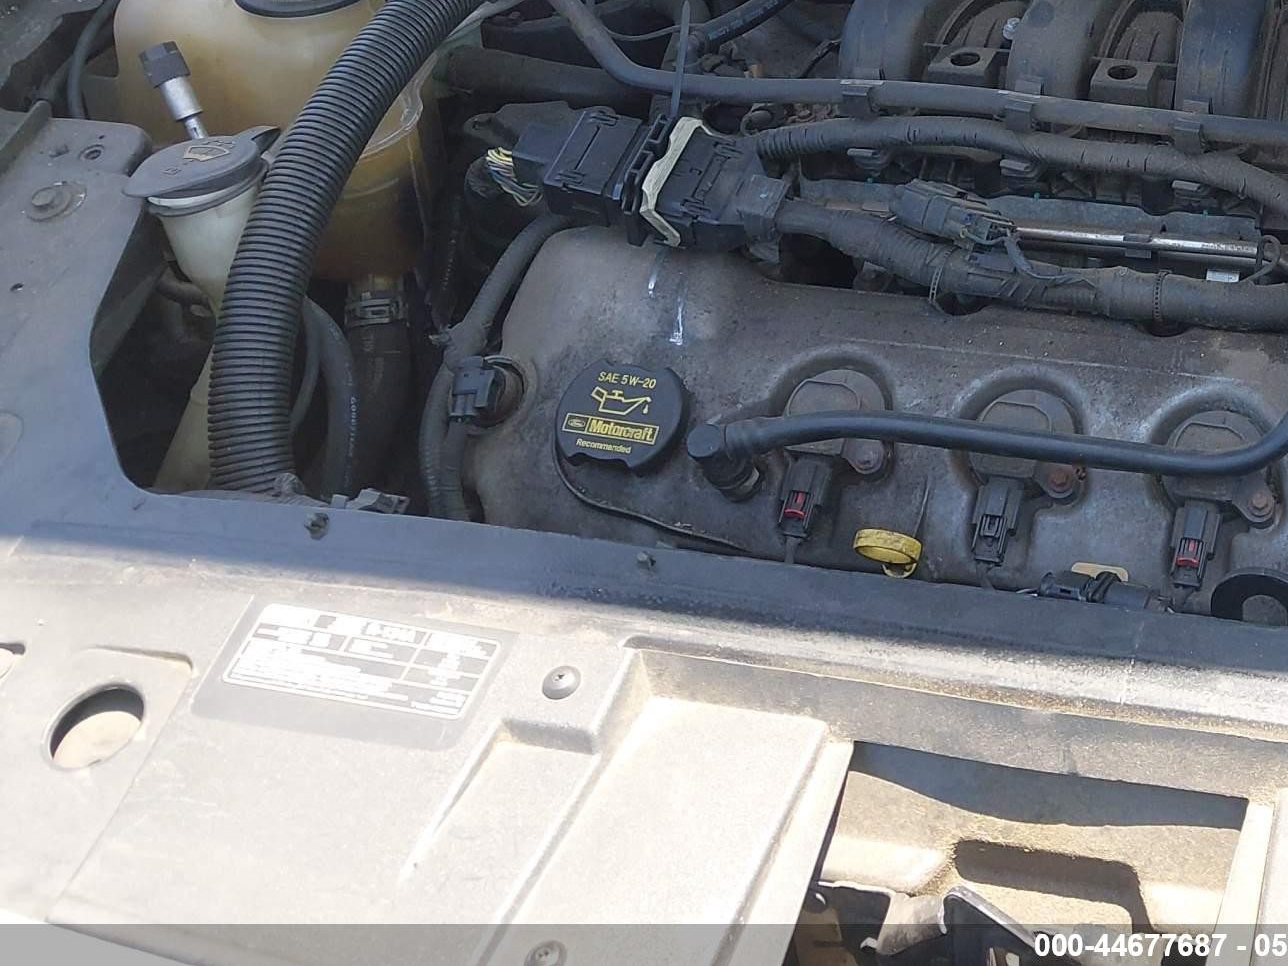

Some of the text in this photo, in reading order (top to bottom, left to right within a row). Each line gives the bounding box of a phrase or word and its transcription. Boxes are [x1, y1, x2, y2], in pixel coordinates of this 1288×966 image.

[598, 371, 657, 389] SAE 5W-20
[588, 419, 655, 442] Motorcraft
[576, 438, 632, 454] Recommended
